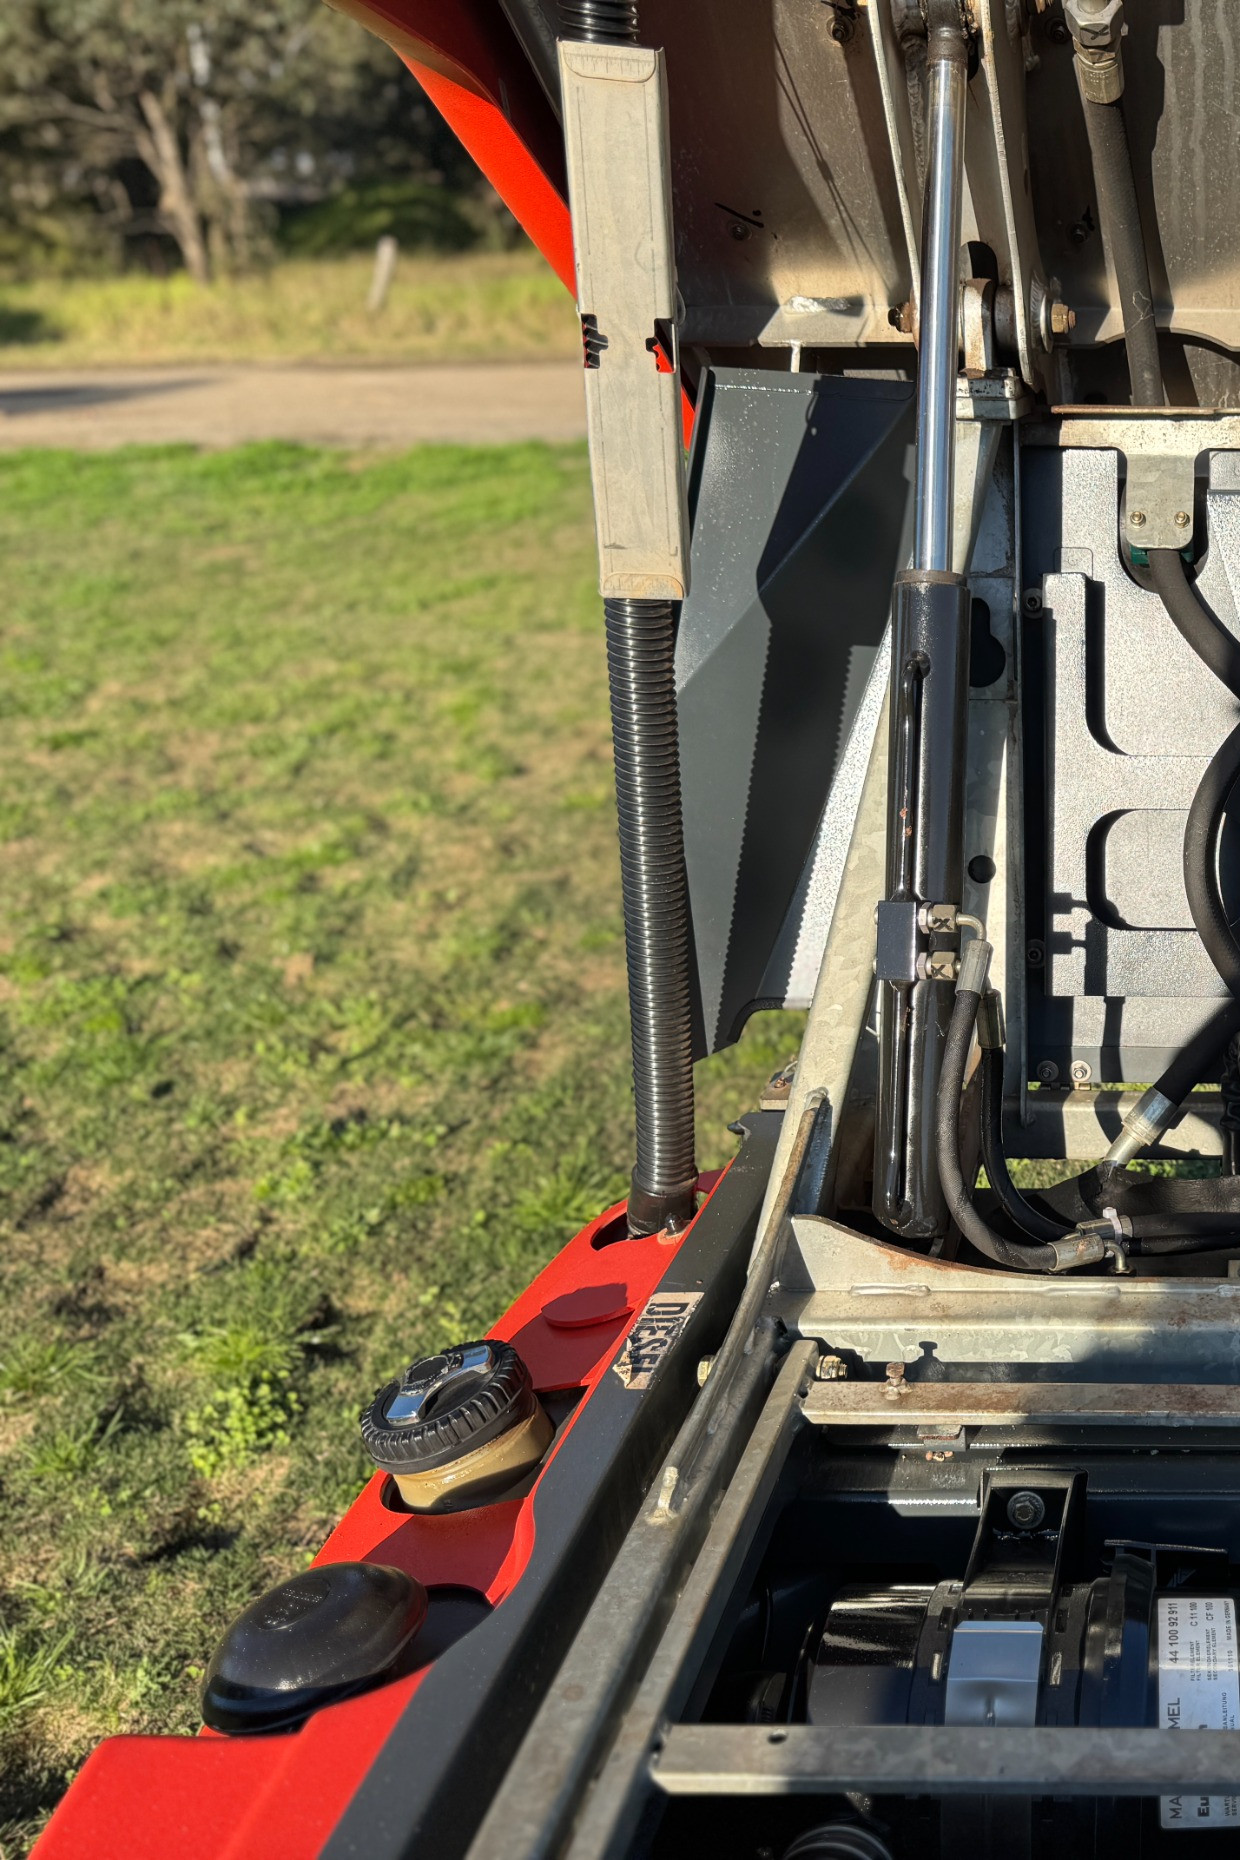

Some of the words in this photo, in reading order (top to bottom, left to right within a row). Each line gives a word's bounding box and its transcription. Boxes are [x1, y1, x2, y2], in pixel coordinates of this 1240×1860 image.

[1168, 1603, 1178, 1615] 911
[1168, 1616, 1178, 1627] 92
[1205, 1612, 1214, 1621] CF
[1168, 1629, 1179, 1646] 100
[1169, 1650, 1179, 1664] 44
[1167, 1697, 1180, 1729] MEL
